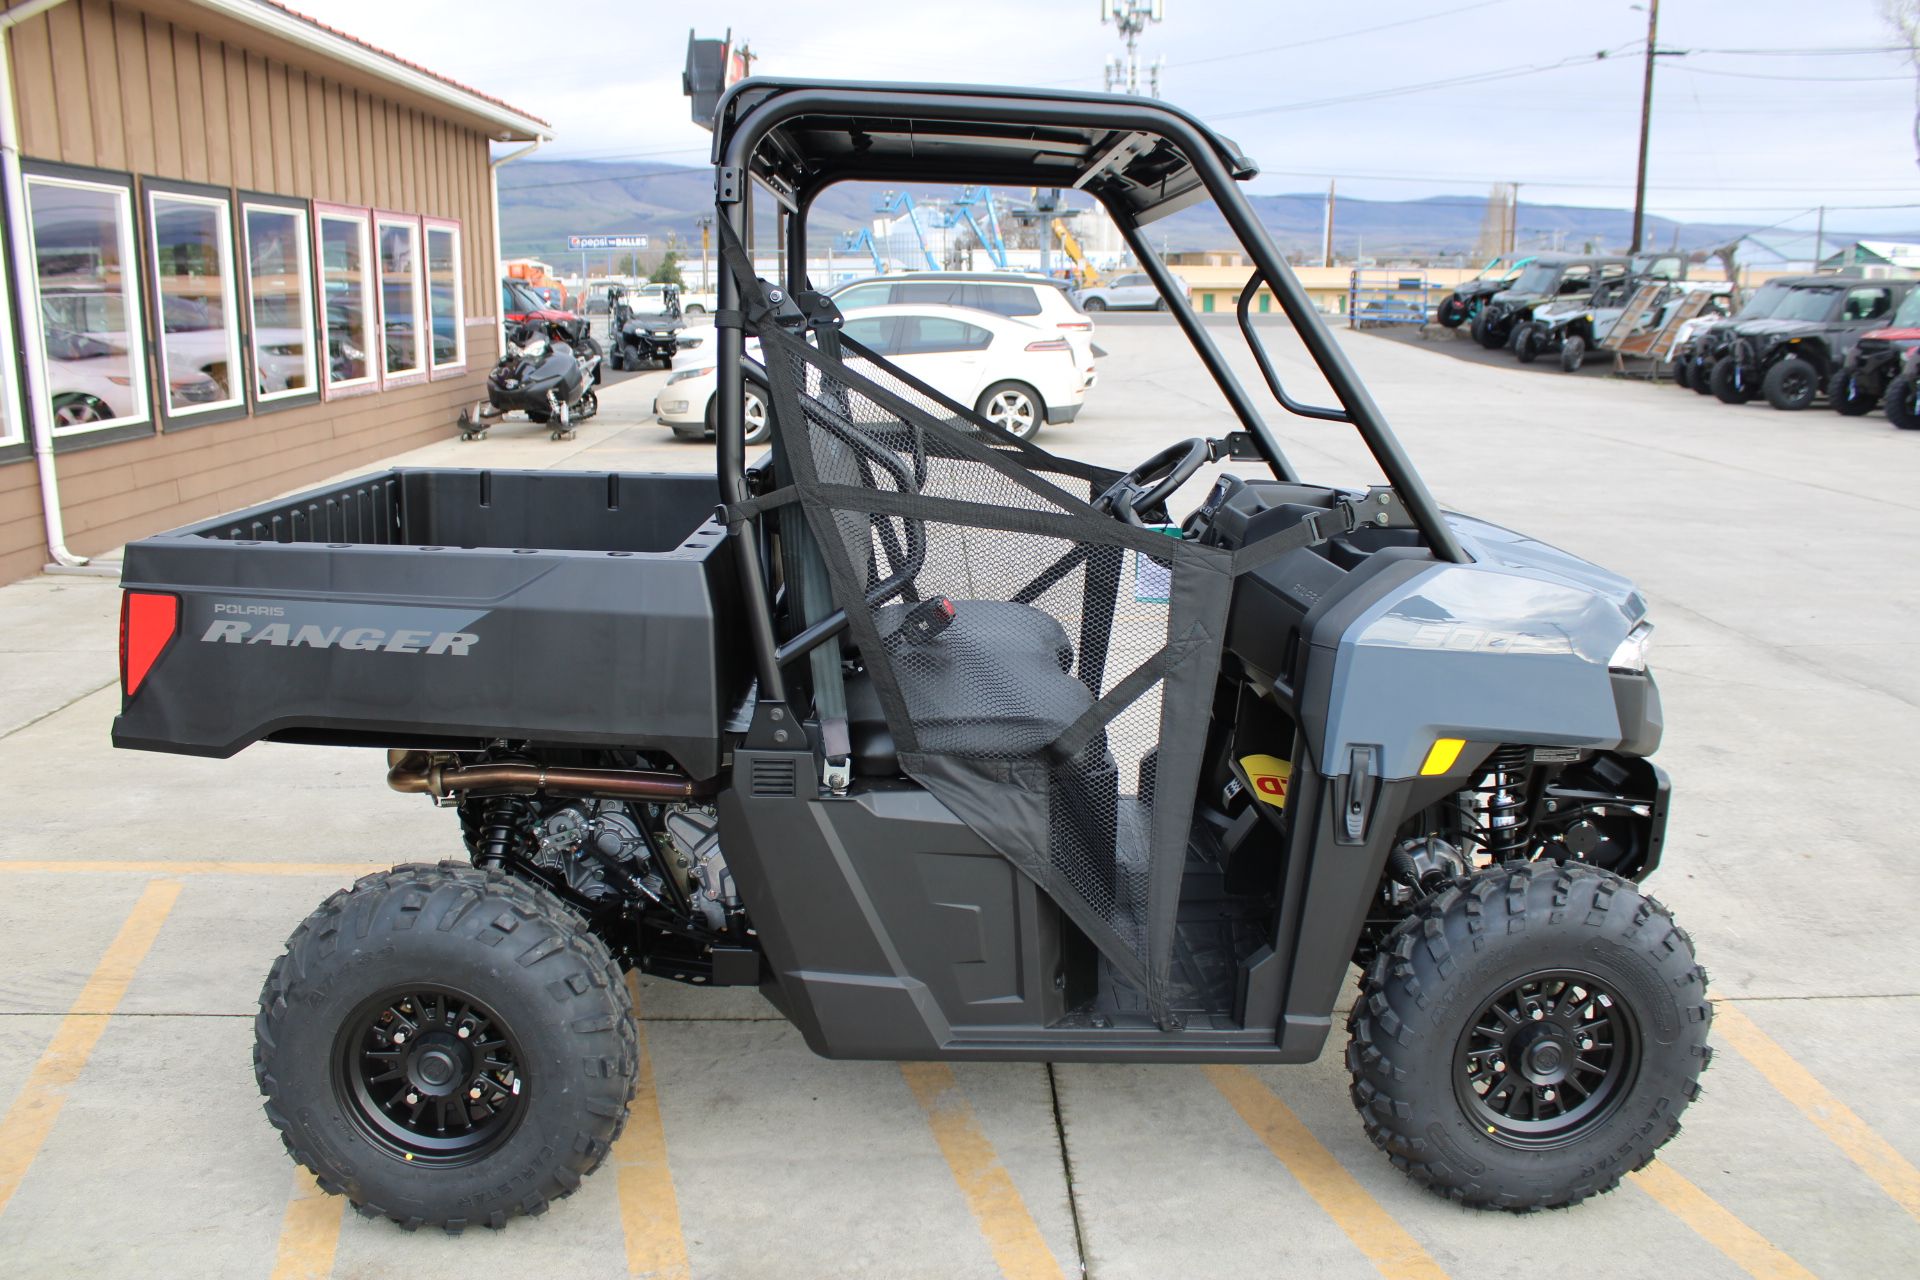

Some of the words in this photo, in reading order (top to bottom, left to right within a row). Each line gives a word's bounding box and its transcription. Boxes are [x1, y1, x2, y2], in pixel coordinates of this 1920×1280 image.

[581, 236, 607, 248] pepsi
[616, 237, 647, 247] DALLES
[213, 603, 285, 617] POLARIS
[200, 619, 480, 656] RANGER
